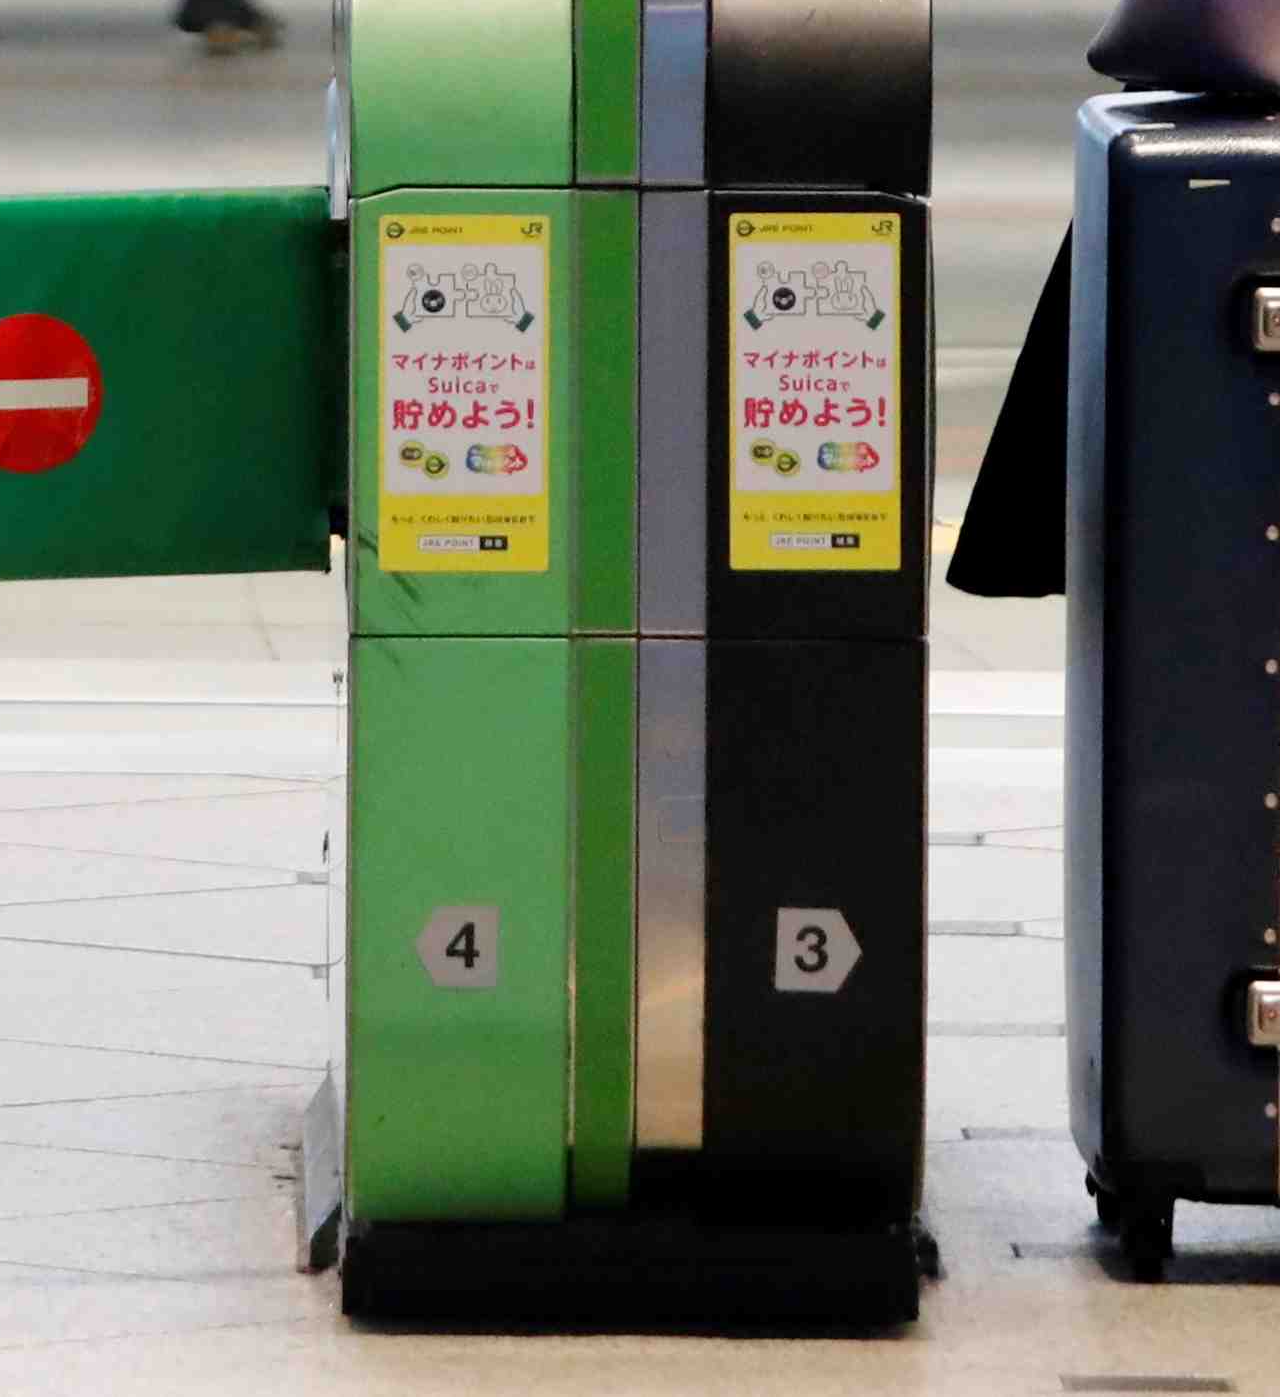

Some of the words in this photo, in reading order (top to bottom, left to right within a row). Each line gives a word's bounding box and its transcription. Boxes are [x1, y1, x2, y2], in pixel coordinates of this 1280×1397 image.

[393, 352, 535, 371] マイナポイントは
[744, 350, 886, 369] マイナポイントは
[393, 399, 535, 430] 貯めよう!
[744, 397, 886, 428] 貯めよう!
[445, 922, 480, 968] 4
[793, 925, 829, 973] 3
